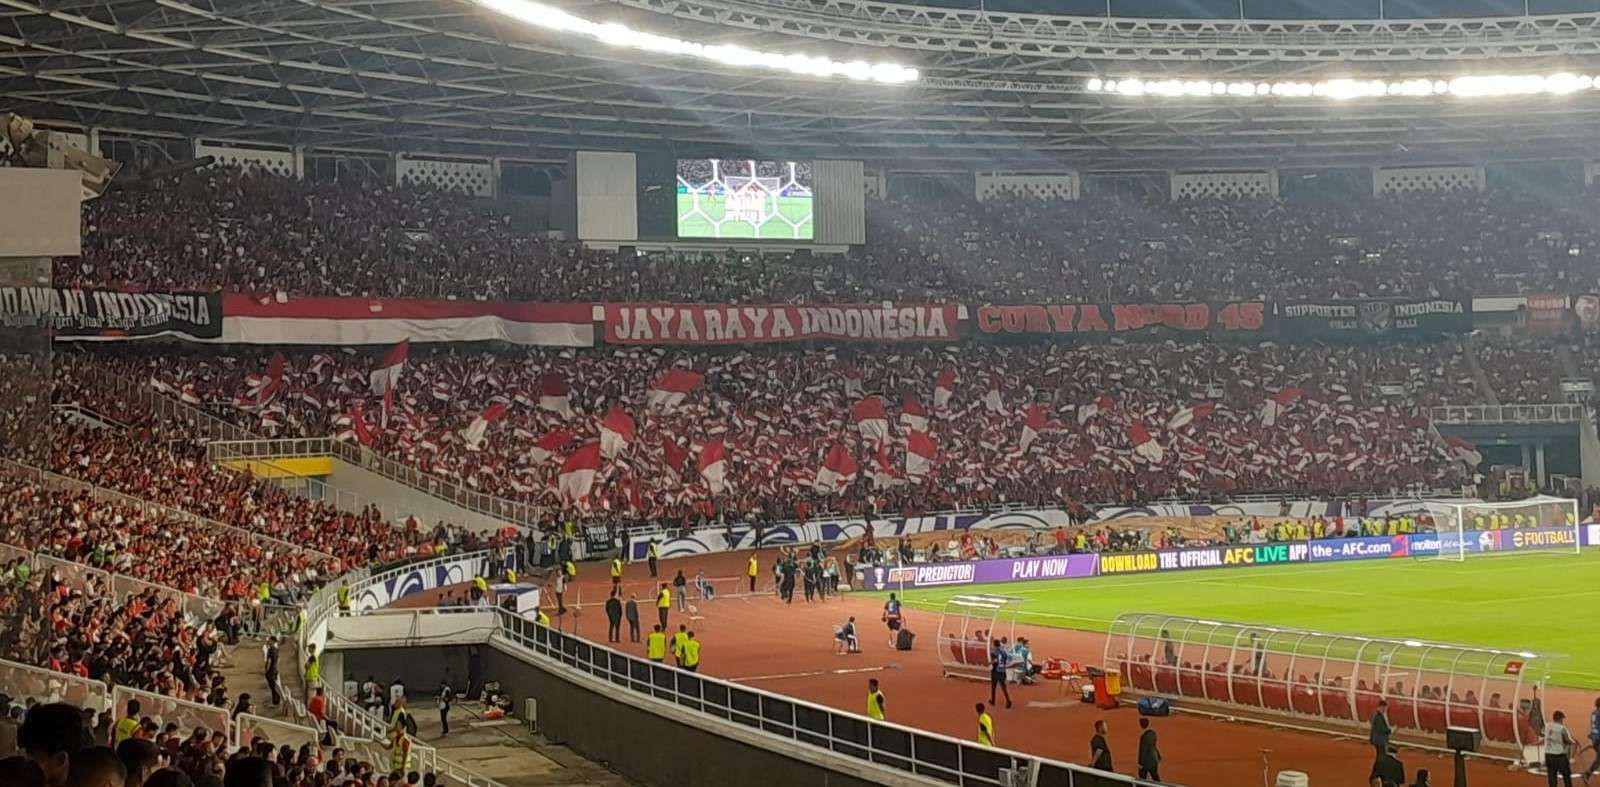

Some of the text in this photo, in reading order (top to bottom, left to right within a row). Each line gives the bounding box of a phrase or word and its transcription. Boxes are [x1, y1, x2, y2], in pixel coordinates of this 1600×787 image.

[0, 287, 210, 326] DAWANI INDONESIA
[977, 303, 1265, 333] CURVA NORD 45
[1285, 304, 1356, 318] SUPPORTER
[1394, 301, 1464, 318] INDONESIA
[614, 307, 949, 341] JAYA RAYA INDONESIA
[1411, 539, 1441, 550] molten
[1012, 558, 1069, 578] PLAY NOW
[1101, 544, 1308, 572] DOWNLOAD THE OFFICIAL AFC LIVE APP
[919, 564, 972, 582] PREDICTOR
